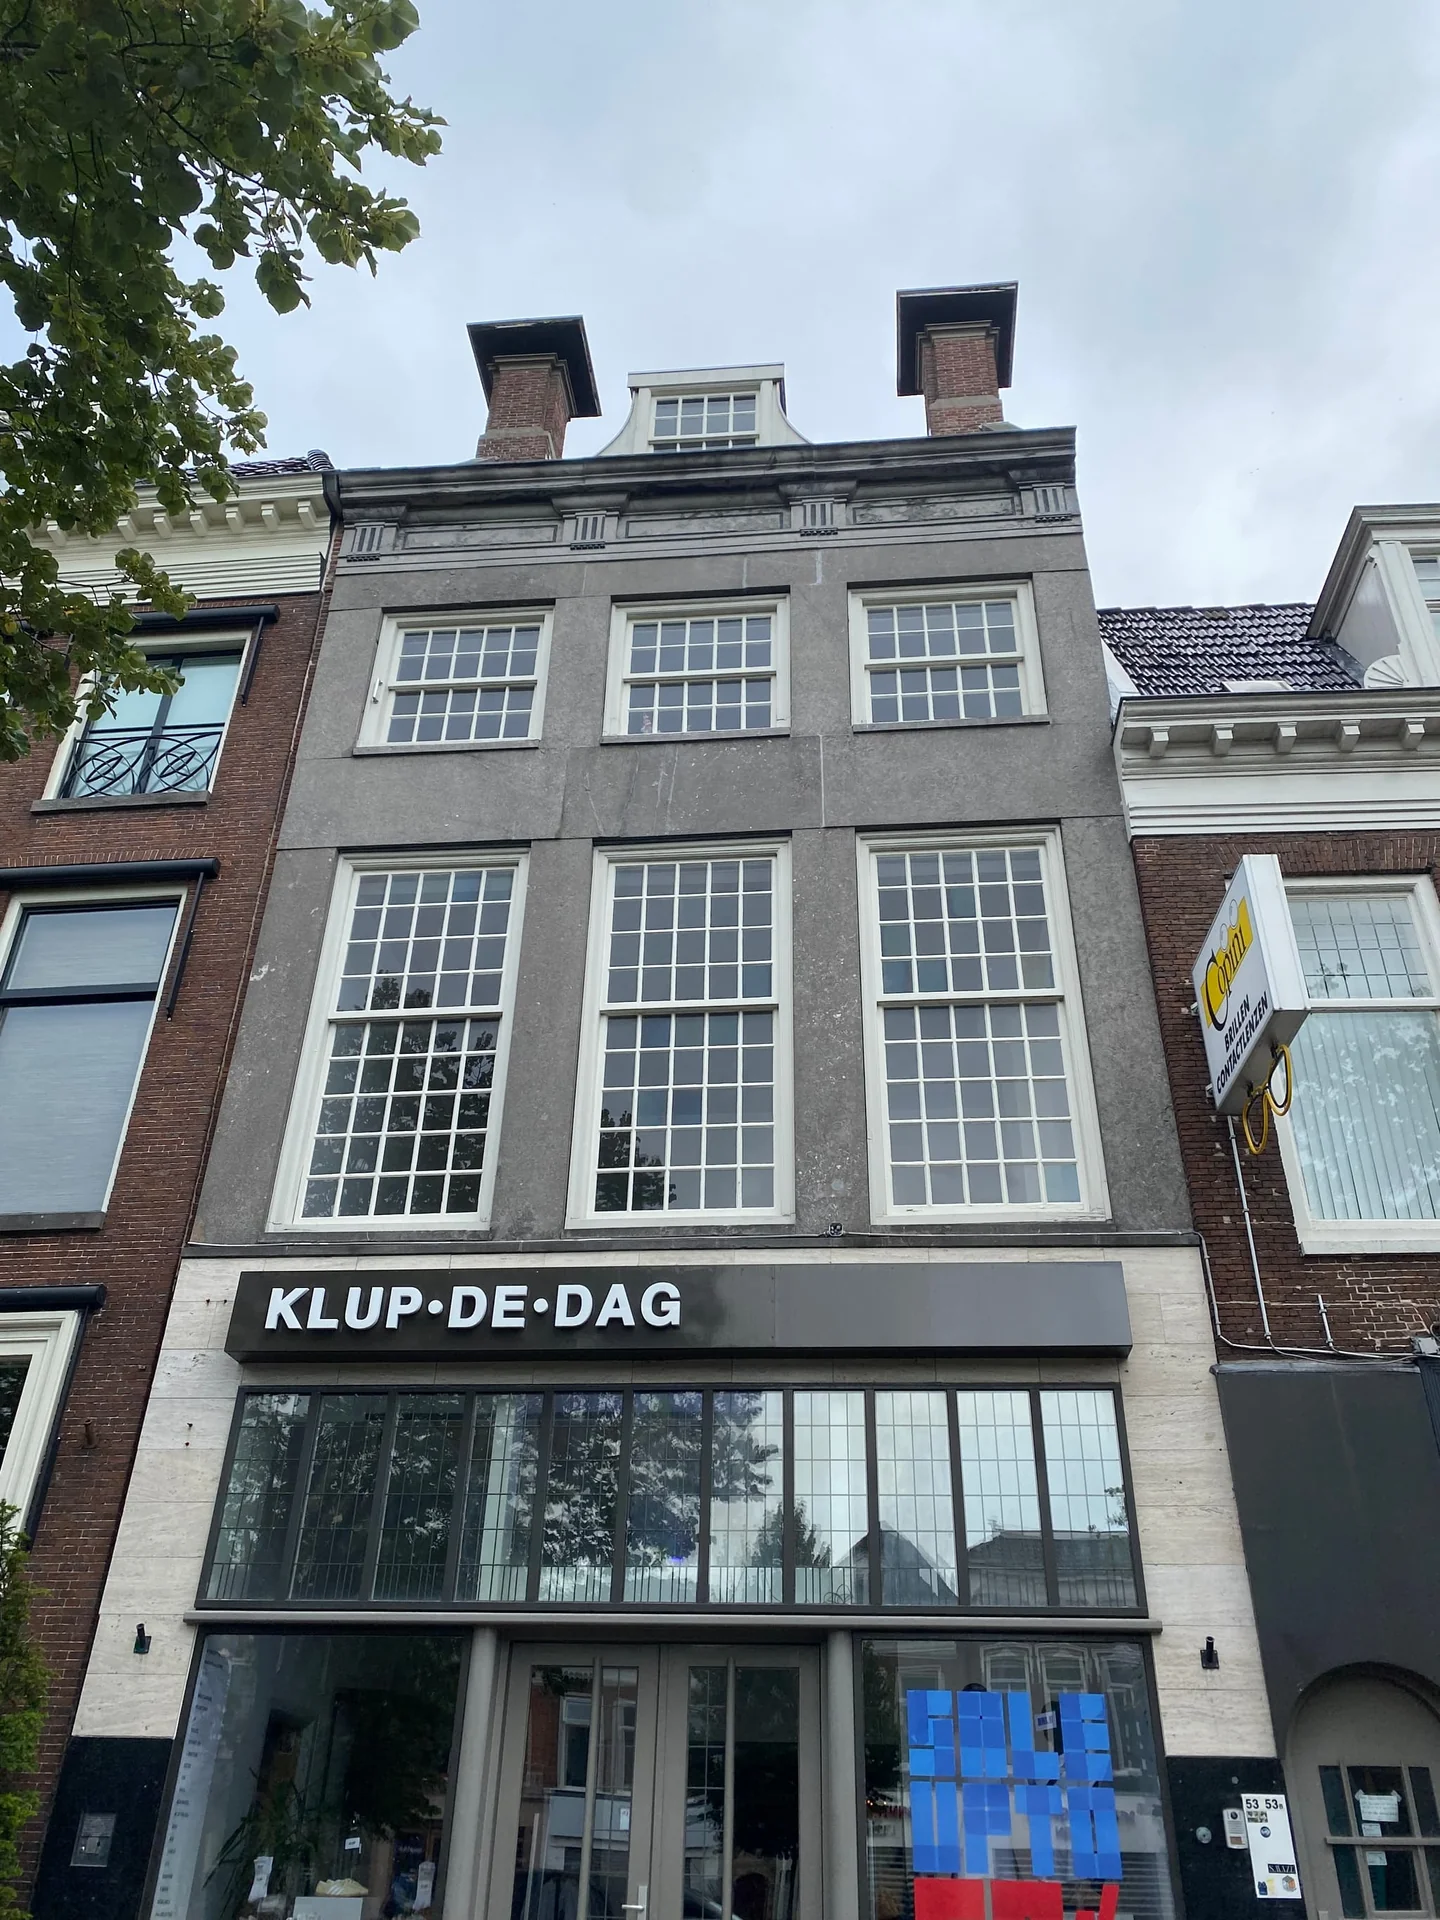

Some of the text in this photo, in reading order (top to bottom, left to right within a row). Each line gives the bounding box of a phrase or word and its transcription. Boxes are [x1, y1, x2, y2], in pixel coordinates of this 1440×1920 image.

[1216, 990, 1268, 1094] CONTACTLENZEN
[1224, 994, 1250, 1053] BRILLEN
[907, 1690, 1113, 1781] SALE
[1245, 1798, 1260, 1810] 53
